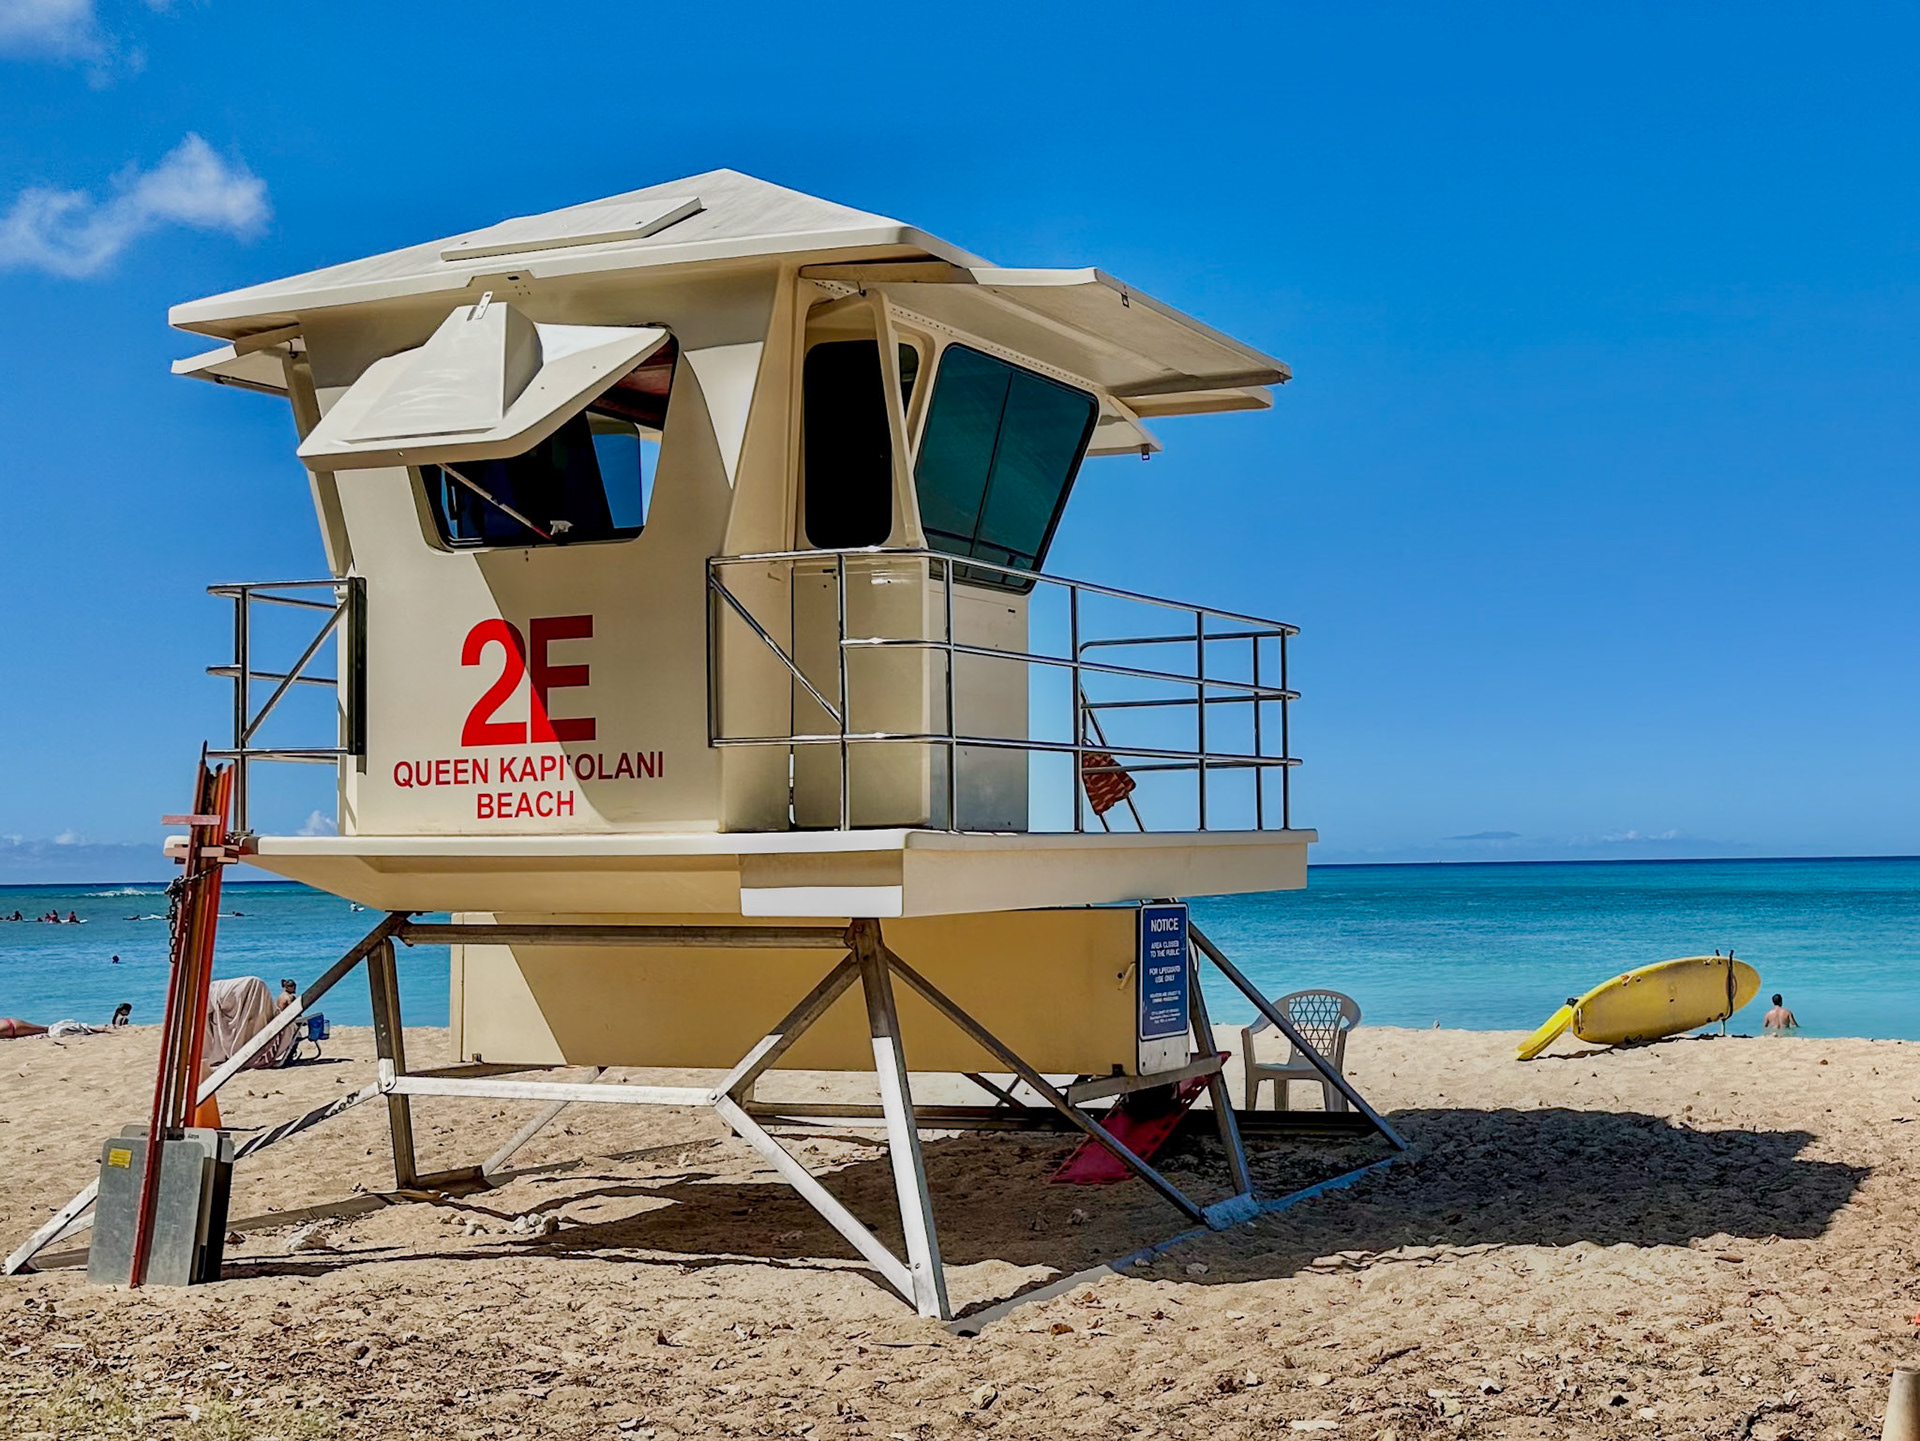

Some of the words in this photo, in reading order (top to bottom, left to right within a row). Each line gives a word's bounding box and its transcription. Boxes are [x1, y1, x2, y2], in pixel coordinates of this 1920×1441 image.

[460, 614, 597, 748] 2E
[393, 758, 489, 789] QUEEN
[476, 790, 575, 819] BEACH
[1151, 918, 1179, 932] NOTICE
[1166, 948, 1180, 956] PUBLIC
[1149, 968, 1158, 976] FOR
